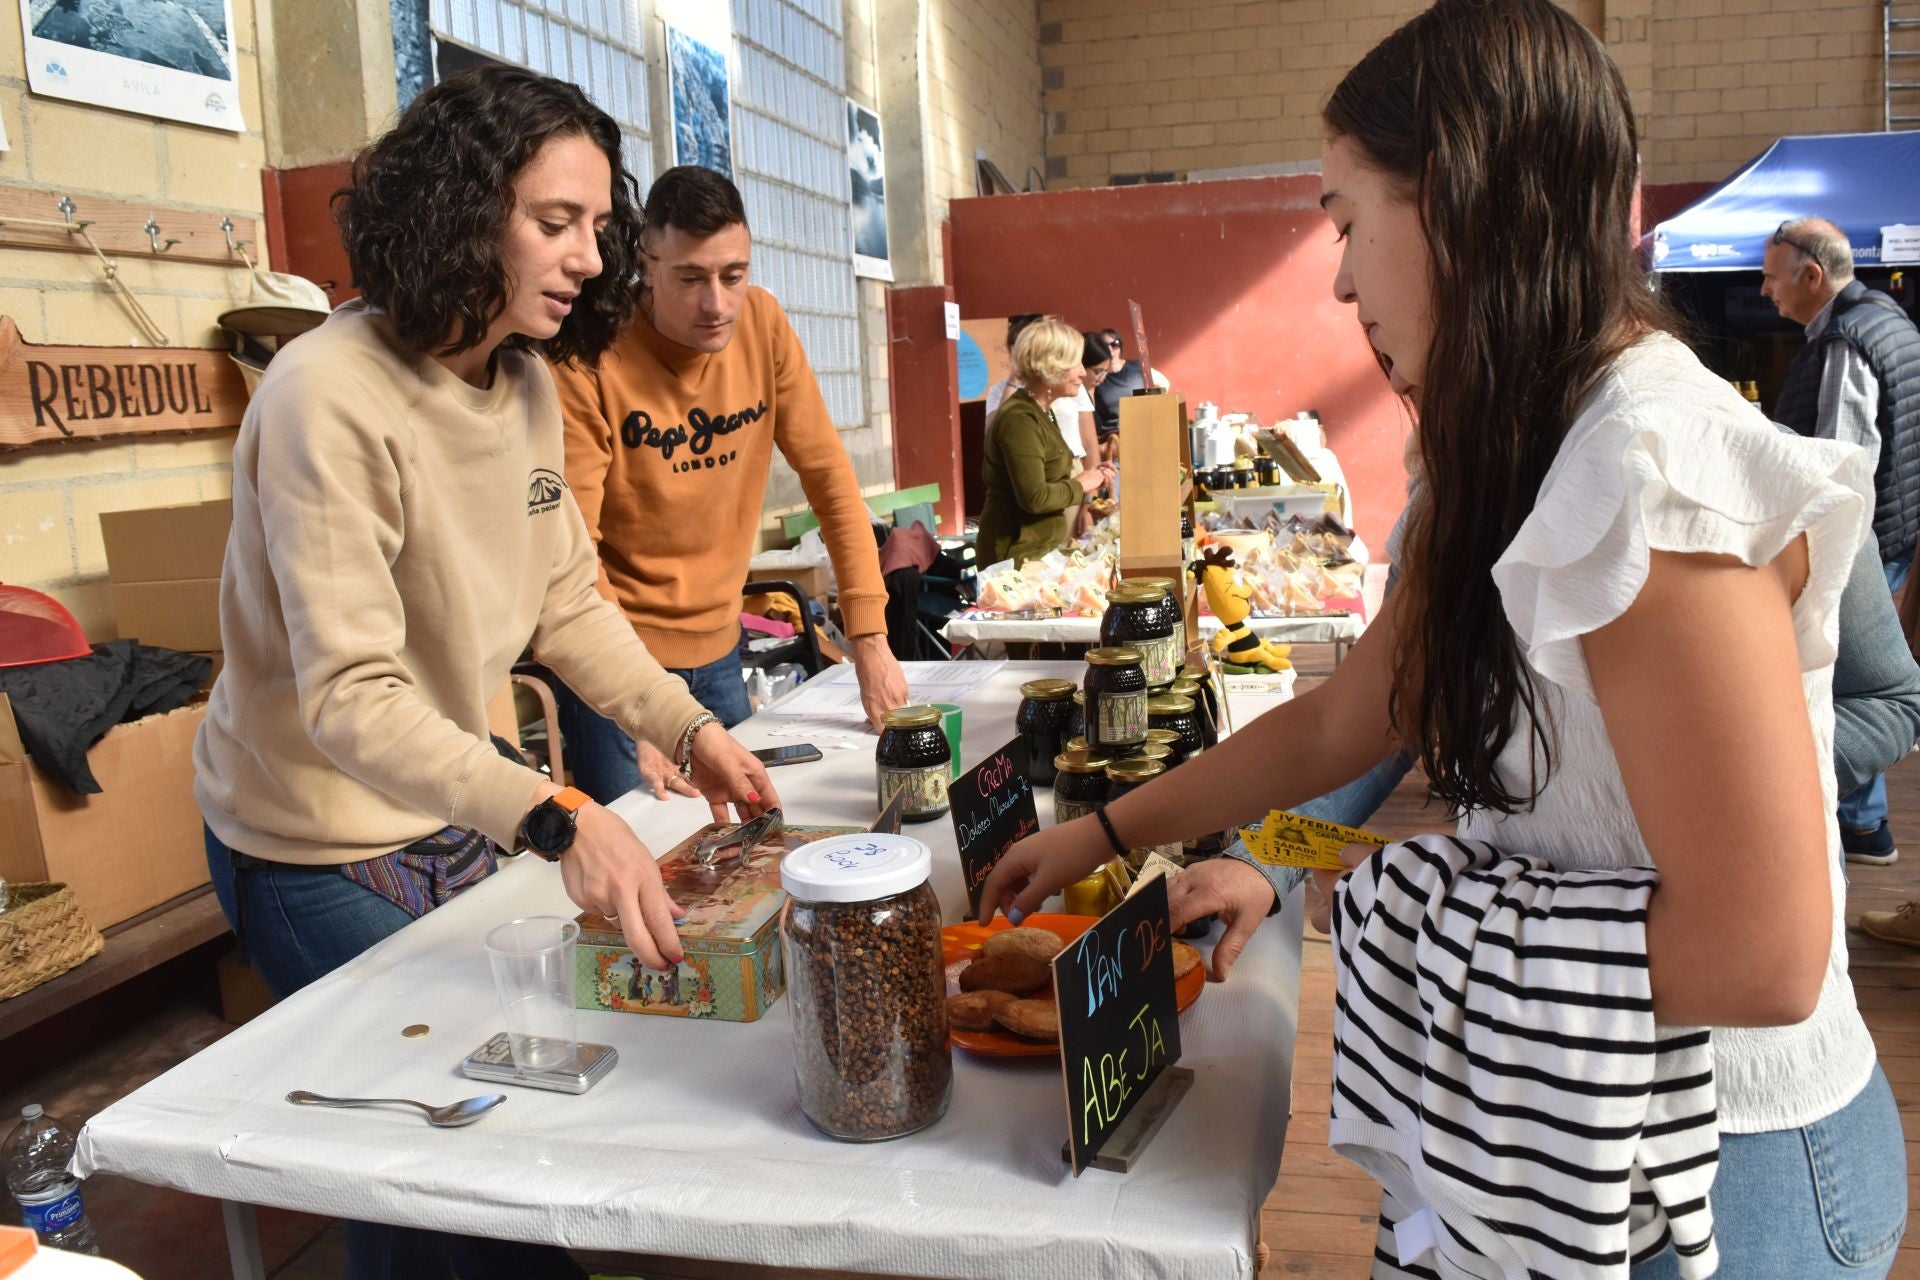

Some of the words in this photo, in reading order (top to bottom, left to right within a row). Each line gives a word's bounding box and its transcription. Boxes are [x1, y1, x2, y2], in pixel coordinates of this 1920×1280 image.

[26, 360, 213, 437] REBEDUL
[621, 410, 688, 460] Pepe
[687, 400, 768, 455] Jeans
[672, 450, 737, 473] LONDON
[1279, 813, 1295, 823] IV
[1299, 818, 1341, 834] FERIA
[1077, 928, 1127, 1018] PAN
[1135, 918, 1166, 973] DE
